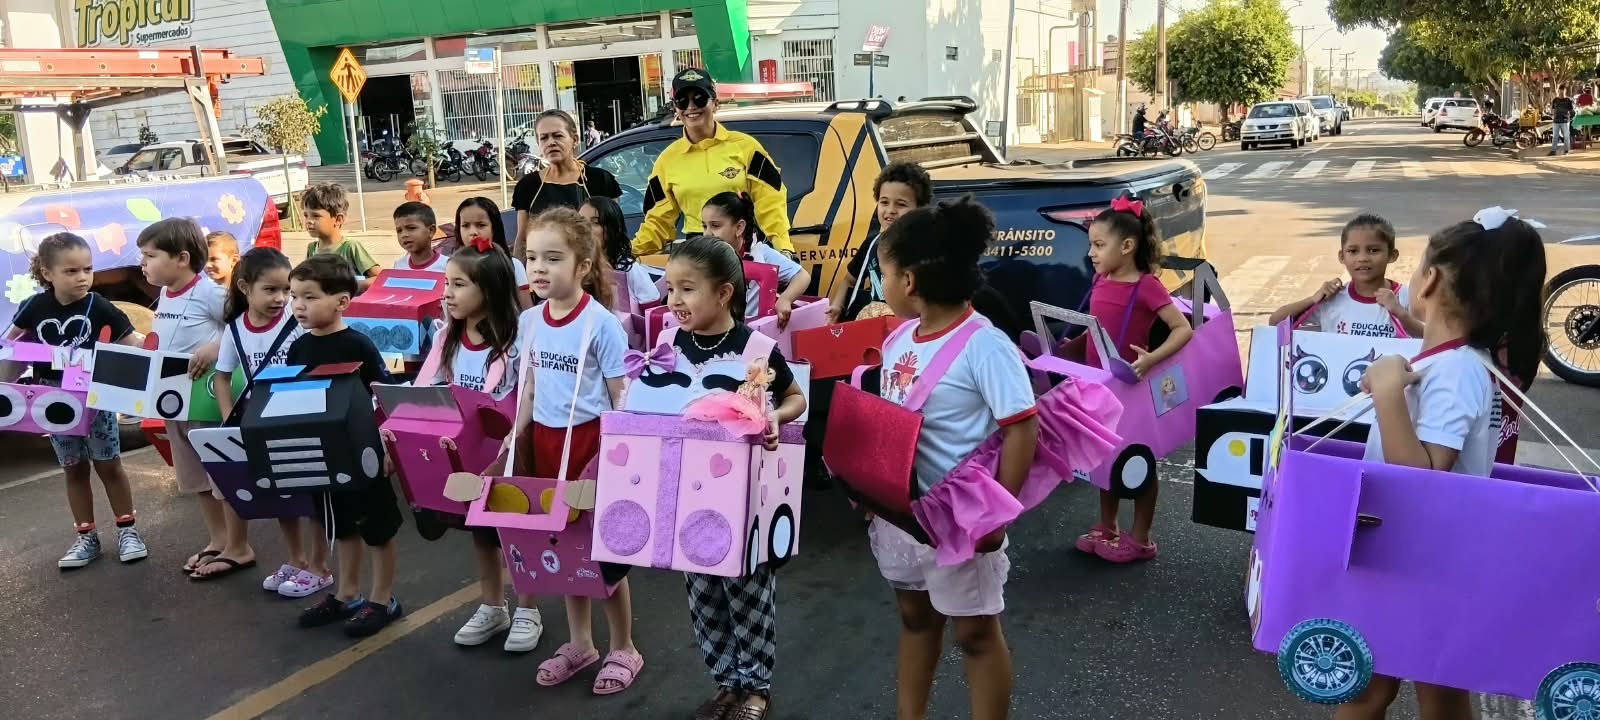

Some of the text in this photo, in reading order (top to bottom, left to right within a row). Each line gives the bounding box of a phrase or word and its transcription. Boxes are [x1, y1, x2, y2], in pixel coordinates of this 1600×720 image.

[75, 0, 192, 48] Tropical
[136, 26, 189, 43] Supermercados
[990, 227, 1056, 241] TRÂNSITO
[984, 246, 1053, 257] 3411-5300
[1350, 329, 1392, 338] INFANTIL
[1351, 322, 1395, 333] EDUCAÇÃO
[540, 351, 579, 366] EDUCAÇÃO
[541, 359, 577, 374] INFANTIL
[460, 373, 486, 385] EDUCA
